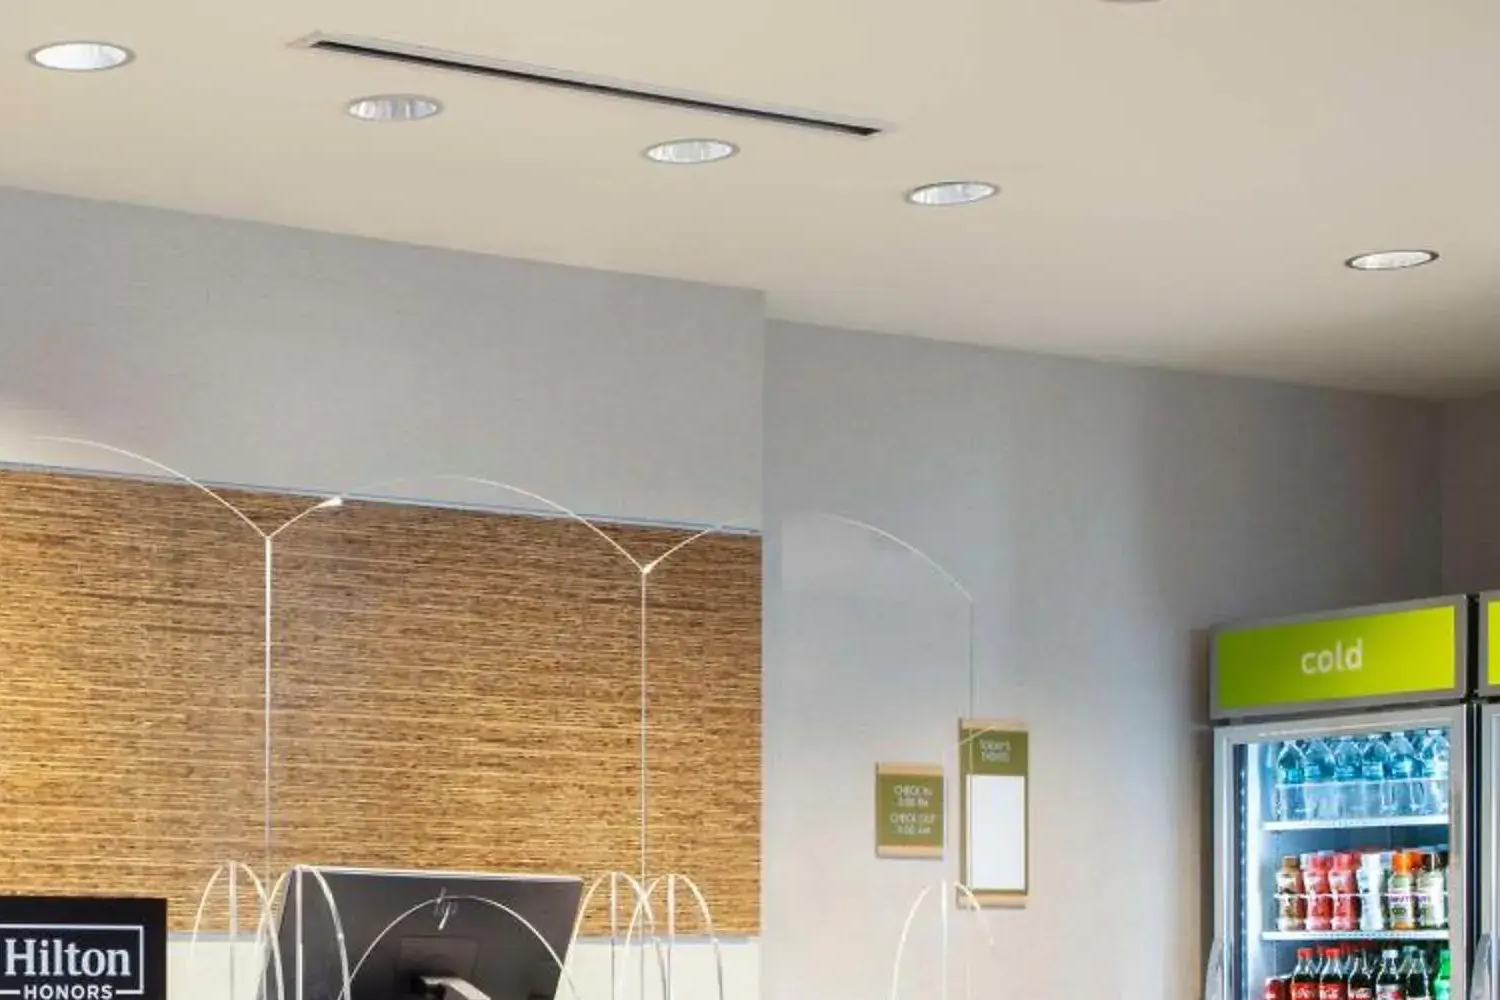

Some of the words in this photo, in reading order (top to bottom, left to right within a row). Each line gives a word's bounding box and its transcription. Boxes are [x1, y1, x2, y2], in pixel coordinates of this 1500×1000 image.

[1300, 637, 1364, 676] cold
[4, 938, 131, 977] Hilton
[23, 984, 113, 1000] HONORS
